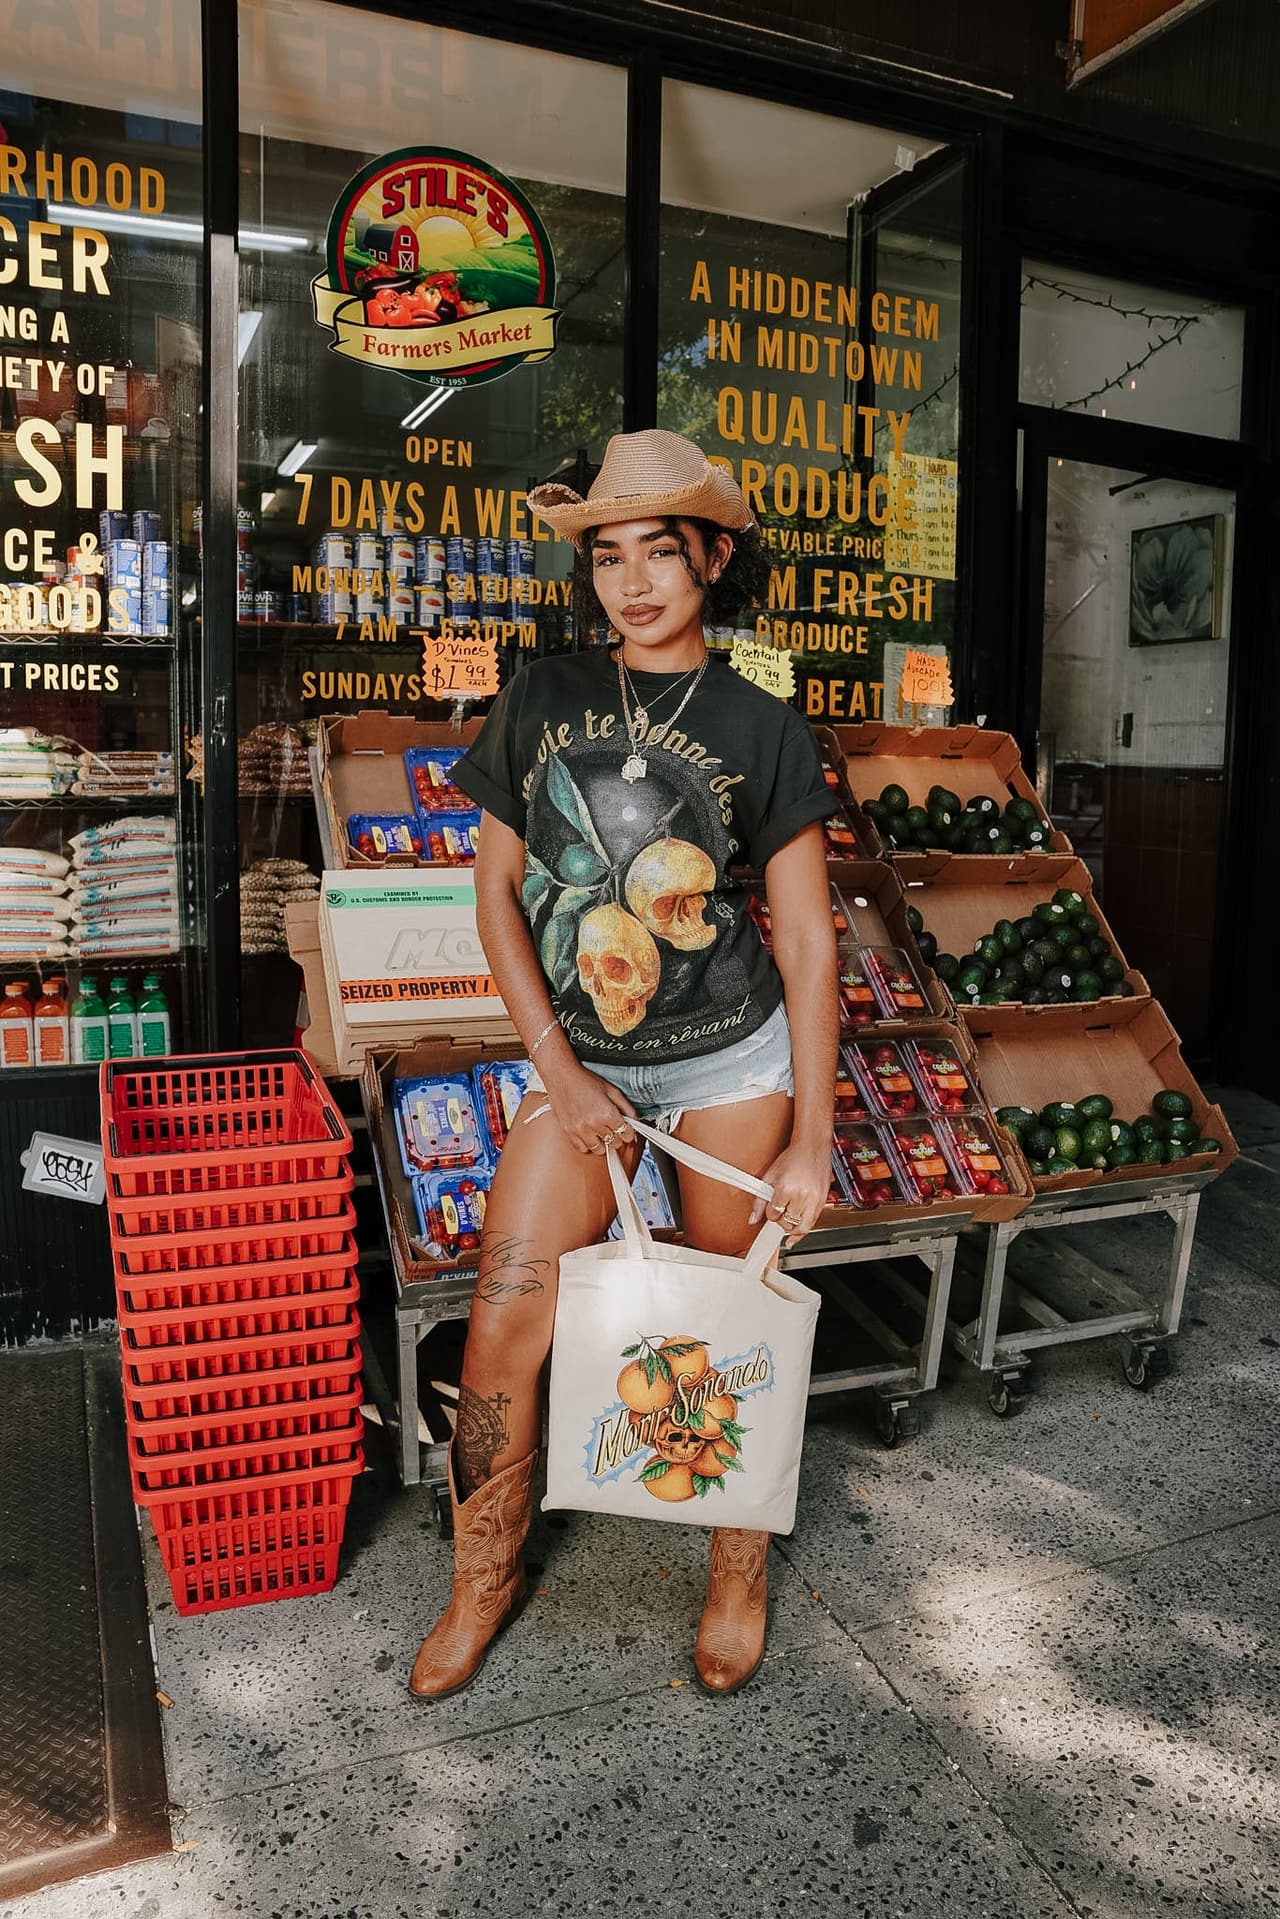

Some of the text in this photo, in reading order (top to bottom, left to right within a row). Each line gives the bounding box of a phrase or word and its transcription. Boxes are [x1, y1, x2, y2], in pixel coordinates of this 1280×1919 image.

[382, 168, 508, 238] STILE'S
[690, 261, 939, 342] A HIDDEN GEM
[51, 311, 70, 344] A
[362, 323, 532, 358] Farmers Market
[707, 318, 922, 391] IN MIDTOWN
[0, 355, 115, 397] ETY OF
[429, 375, 467, 386] EST 1953
[717, 386, 912, 461] QUALITY
[14, 418, 123, 511] SH
[405, 435, 473, 468] OPEN
[294, 473, 562, 543] 7 DAYS A WE
[4, 528, 104, 576] CE &
[842, 535, 904, 562] PRICES
[0, 583, 131, 629] GOODS
[292, 565, 400, 599] MONDAY
[446, 573, 574, 607] SATURDAY
[813, 568, 933, 622] FRESH
[335, 614, 347, 641] 7
[359, 616, 398, 642] AM
[755, 619, 869, 654] PRODUCE
[0, 662, 120, 691] T PRICES
[302, 671, 421, 702] SUNDAYS
[807, 678, 884, 719] BEAT
[537, 721, 574, 764] vie
[584, 709, 616, 740] te
[709, 774, 745, 826] des
[341, 983, 393, 1000] SEIZED
[399, 979, 478, 997] PROPERTY
[633, 1036, 662, 1050] en
[667, 993, 752, 1047] rêvant
